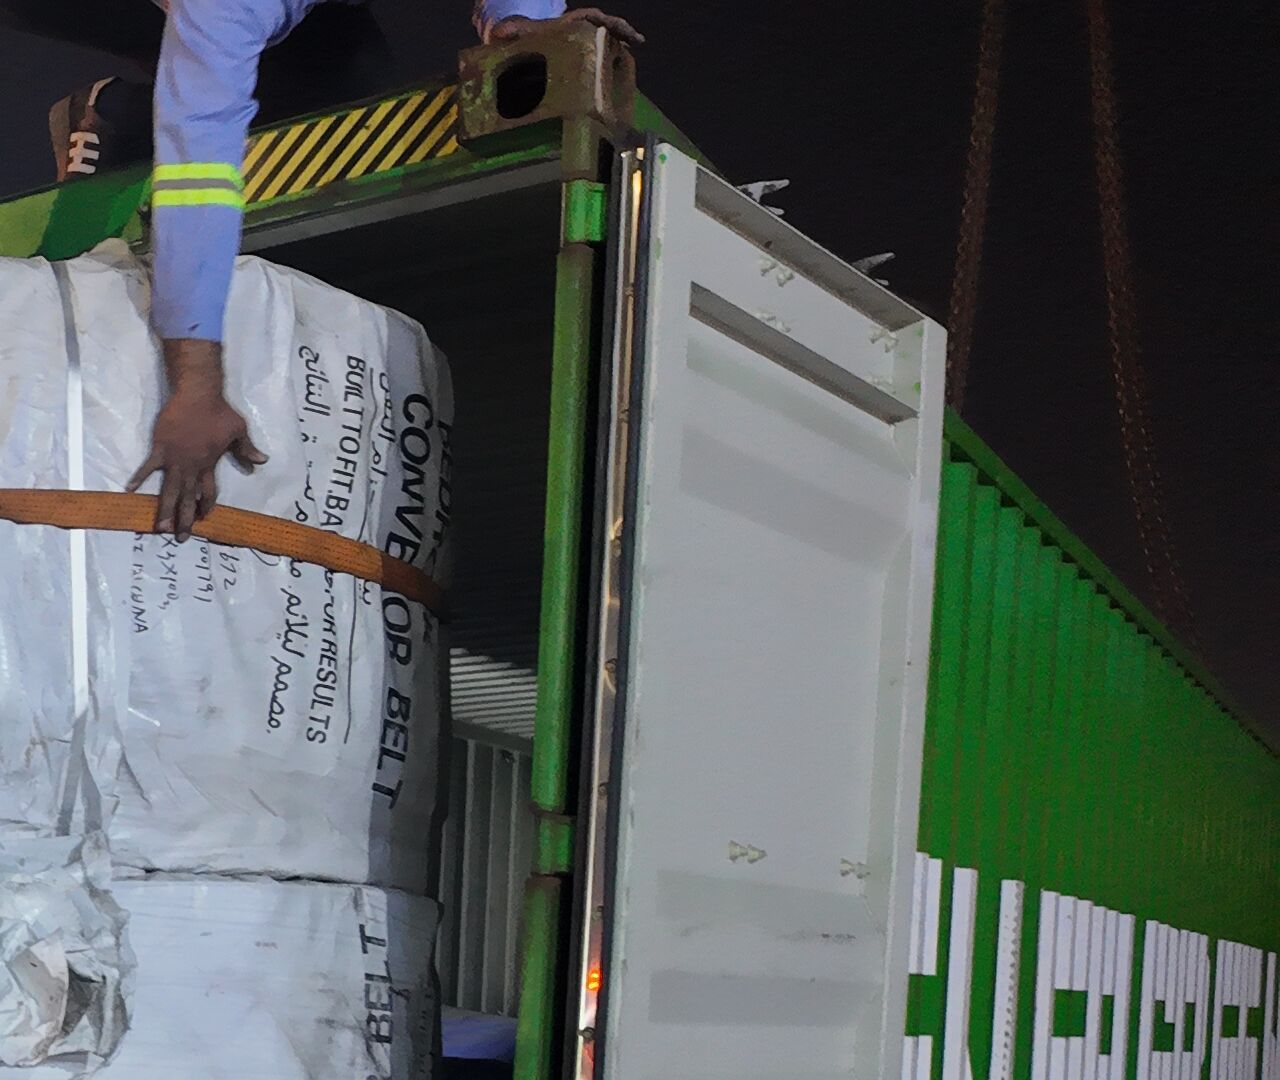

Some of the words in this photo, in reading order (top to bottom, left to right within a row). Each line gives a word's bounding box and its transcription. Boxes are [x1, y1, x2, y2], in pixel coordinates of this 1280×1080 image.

[382, 393, 434, 667] CONVEOR
[305, 637, 339, 745] RESULTS
[371, 686, 412, 810] BELT
[359, 924, 394, 1045] BELT
